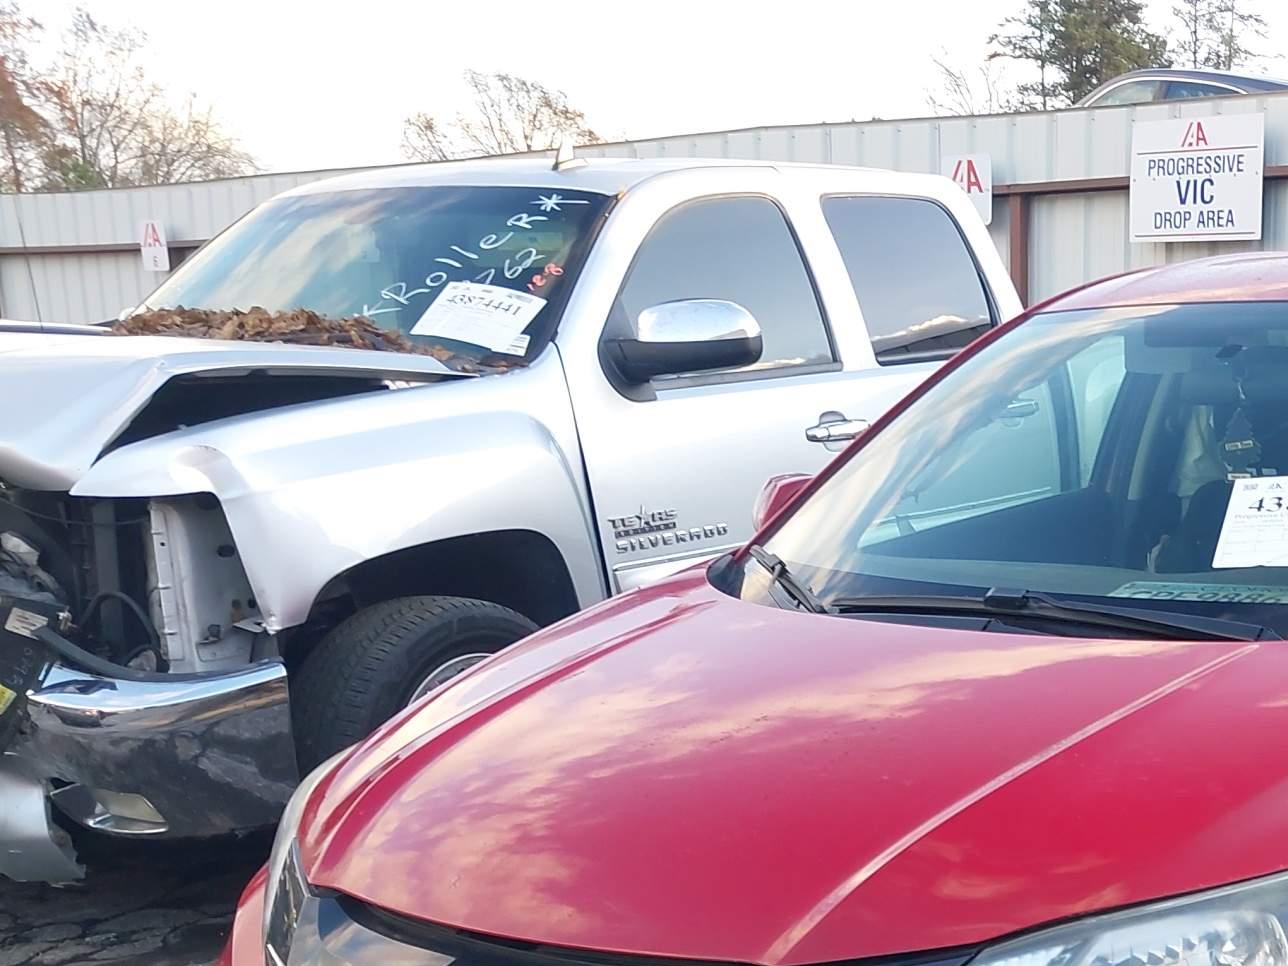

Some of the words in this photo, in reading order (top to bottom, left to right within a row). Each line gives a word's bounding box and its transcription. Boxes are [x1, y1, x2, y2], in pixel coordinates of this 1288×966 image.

[1147, 154, 1245, 177] PROGRESSIVE
[1176, 178, 1215, 205] VIC
[1154, 211, 1192, 230] DROP
[1196, 209, 1235, 229] AREA
[615, 522, 729, 555] SILVERADO
